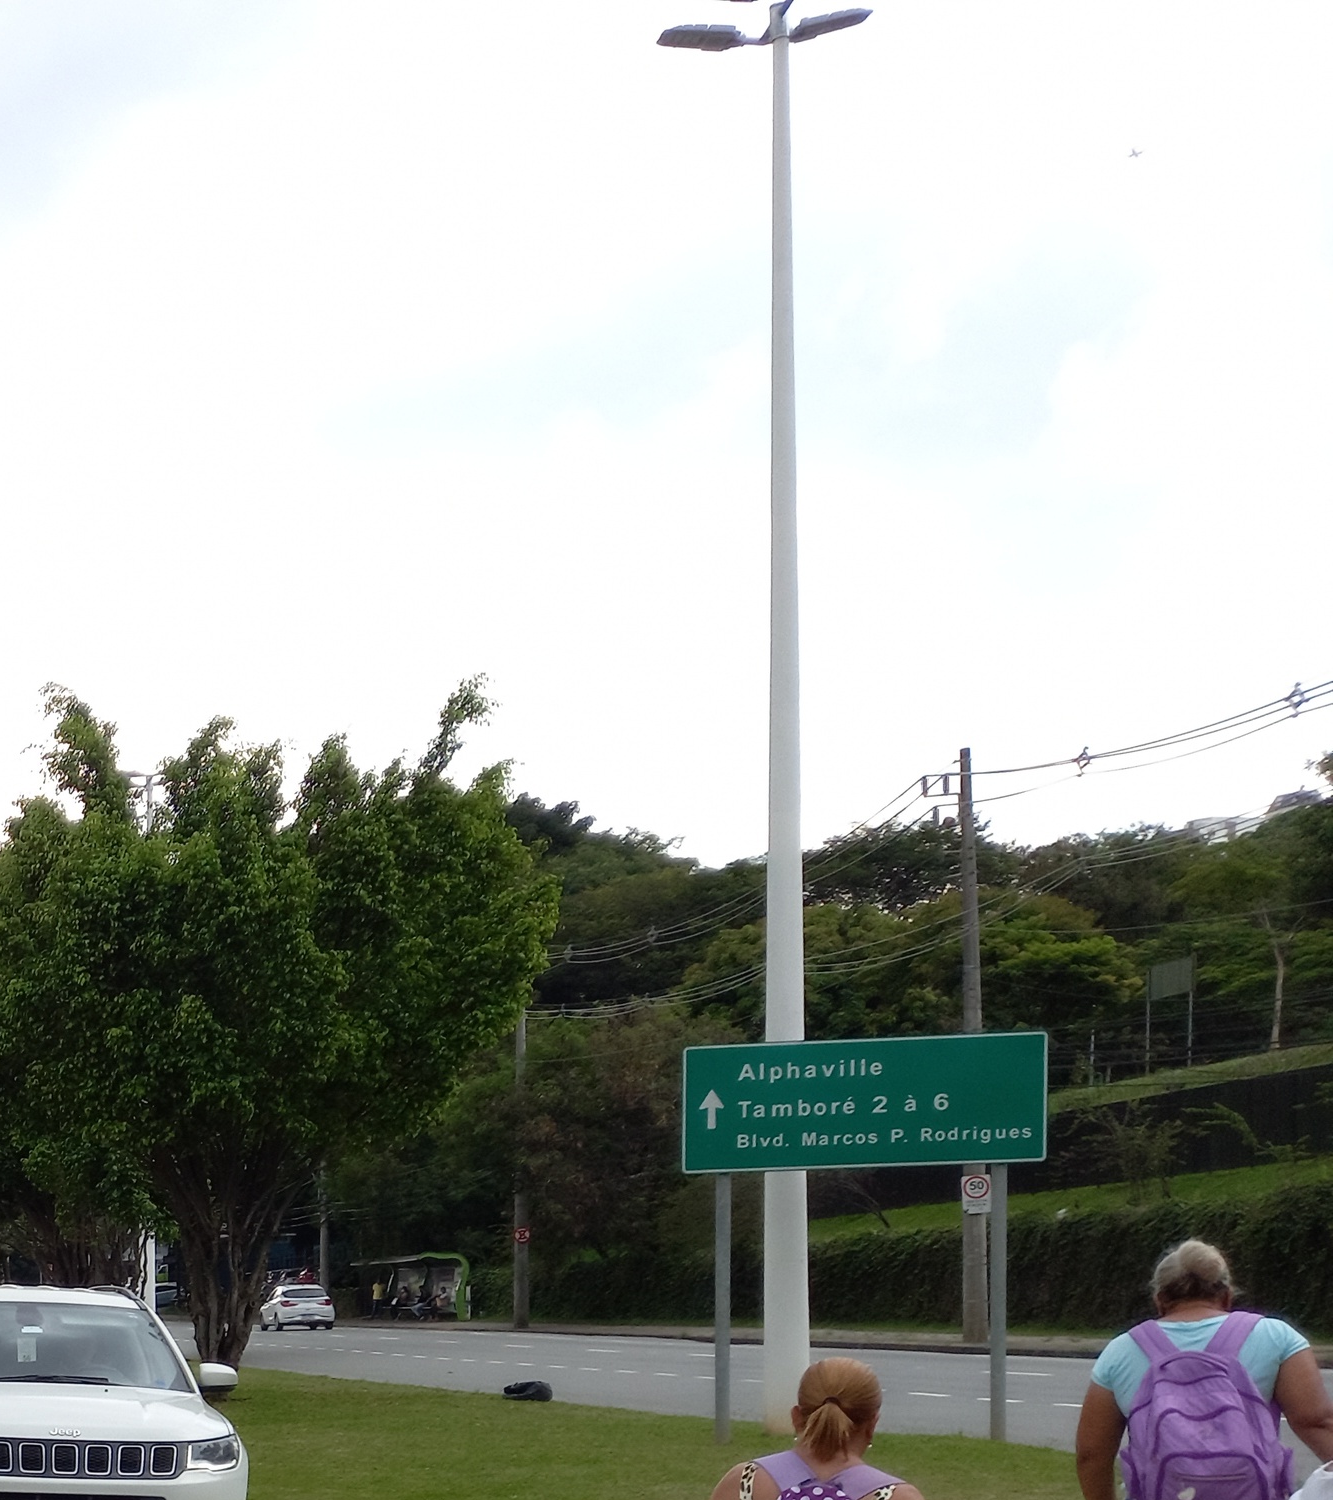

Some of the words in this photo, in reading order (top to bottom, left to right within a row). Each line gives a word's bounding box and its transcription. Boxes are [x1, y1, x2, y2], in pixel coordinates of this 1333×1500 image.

[737, 1058, 883, 1084] Alphaville
[738, 1096, 856, 1119] Tamboré
[871, 1095, 888, 1114] 2
[904, 1095, 917, 1112] à
[933, 1092, 950, 1112] 6
[736, 1132, 790, 1148] Blvd.
[801, 1130, 878, 1147] Marcos
[890, 1128, 908, 1143] P.
[920, 1125, 1033, 1144] Rodrigues
[969, 1181, 985, 1190] 50
[49, 1427, 81, 1438] Jeep
